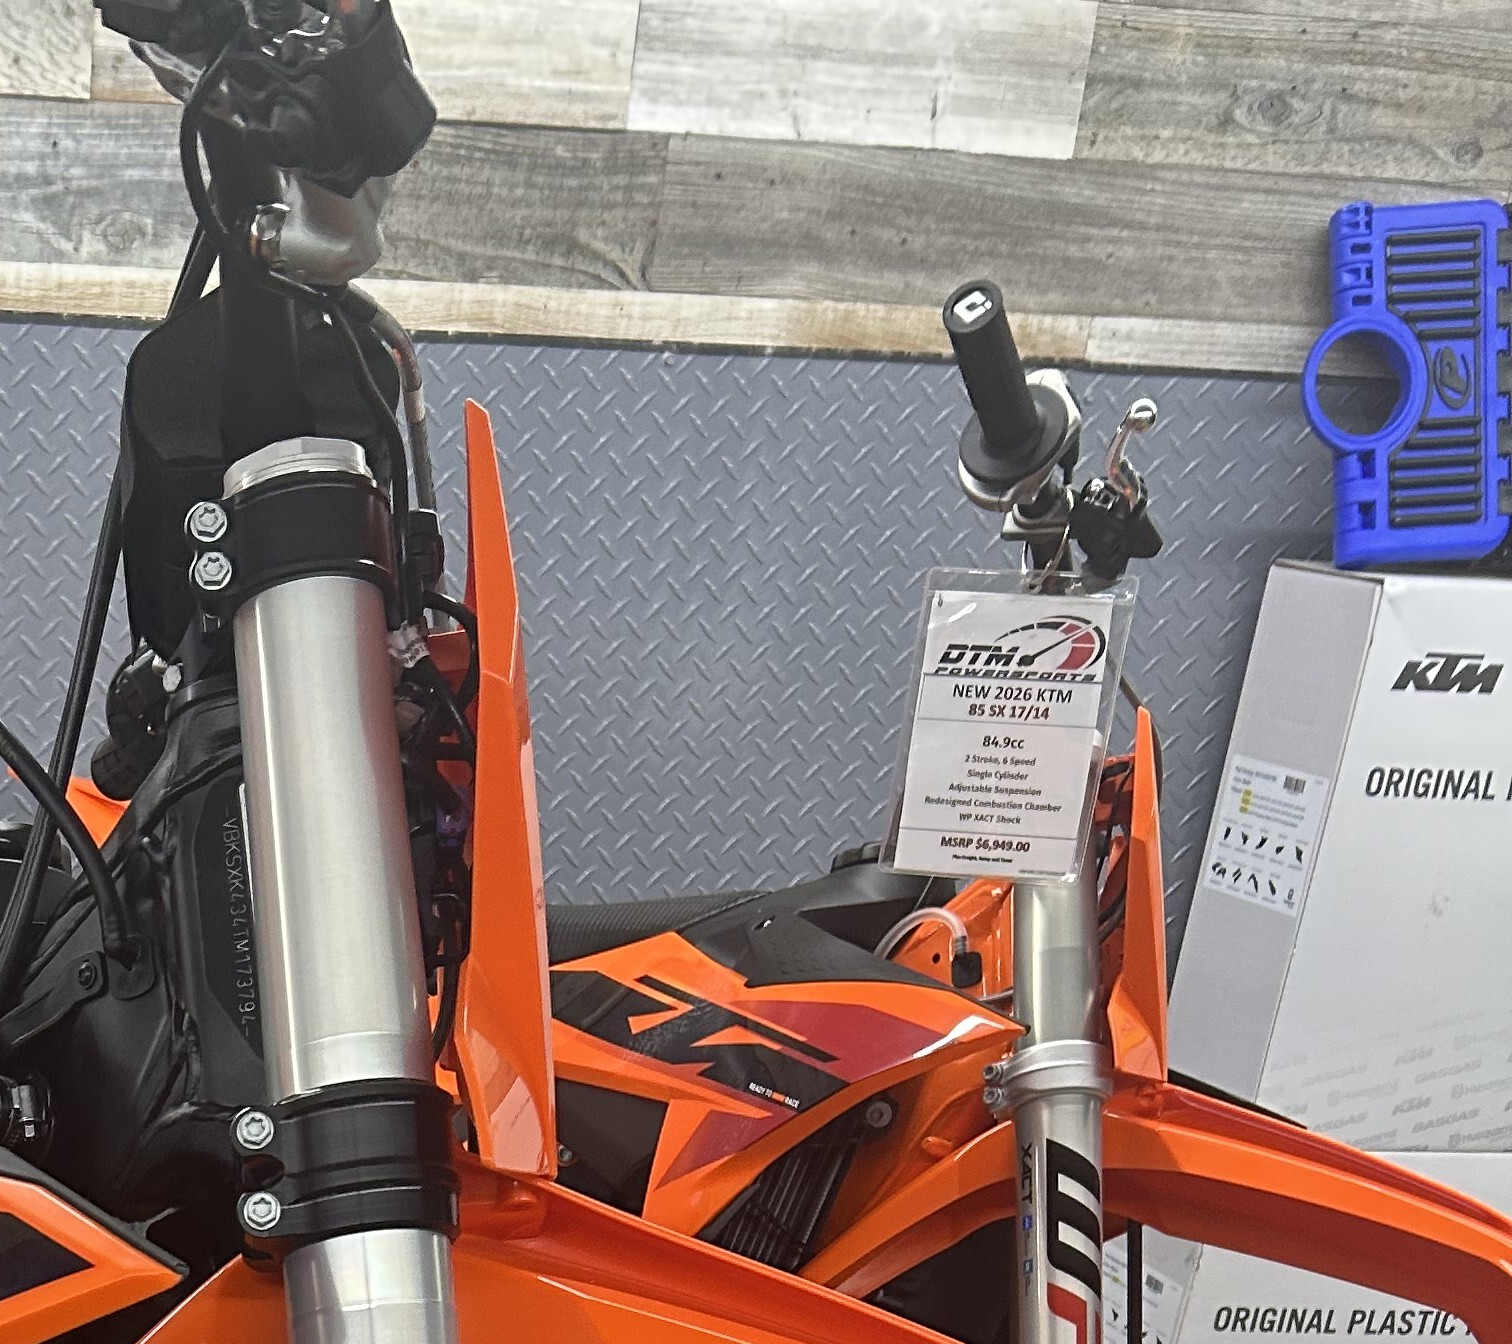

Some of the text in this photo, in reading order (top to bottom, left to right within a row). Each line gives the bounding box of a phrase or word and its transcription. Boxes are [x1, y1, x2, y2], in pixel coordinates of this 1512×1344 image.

[938, 643, 1020, 667] DTM
[934, 666, 1097, 682] POWERSPORTS
[1390, 651, 1504, 696] KTM
[952, 684, 1073, 703] NEW 2026 KTM
[968, 703, 1050, 721] 85 SX 17/14
[982, 735, 1025, 749] 84.9cc
[964, 754, 971, 763] 2
[971, 754, 1001, 766] Stroke,
[1009, 756, 1037, 767] Speed
[967, 769, 1029, 781] Single Cylinder
[1365, 765, 1496, 801] ORIGINAL
[948, 782, 1042, 797] Adjustable Suspension
[924, 795, 1062, 812] Redesigned Combustion Chamber
[959, 812, 1021, 824] WP XACT Shock
[940, 836, 1031, 853] MSRP $6,949.00
[1022, 1142, 1032, 1204] XACT
[1213, 1305, 1471, 1336] ORIGINAL PLASTIC
